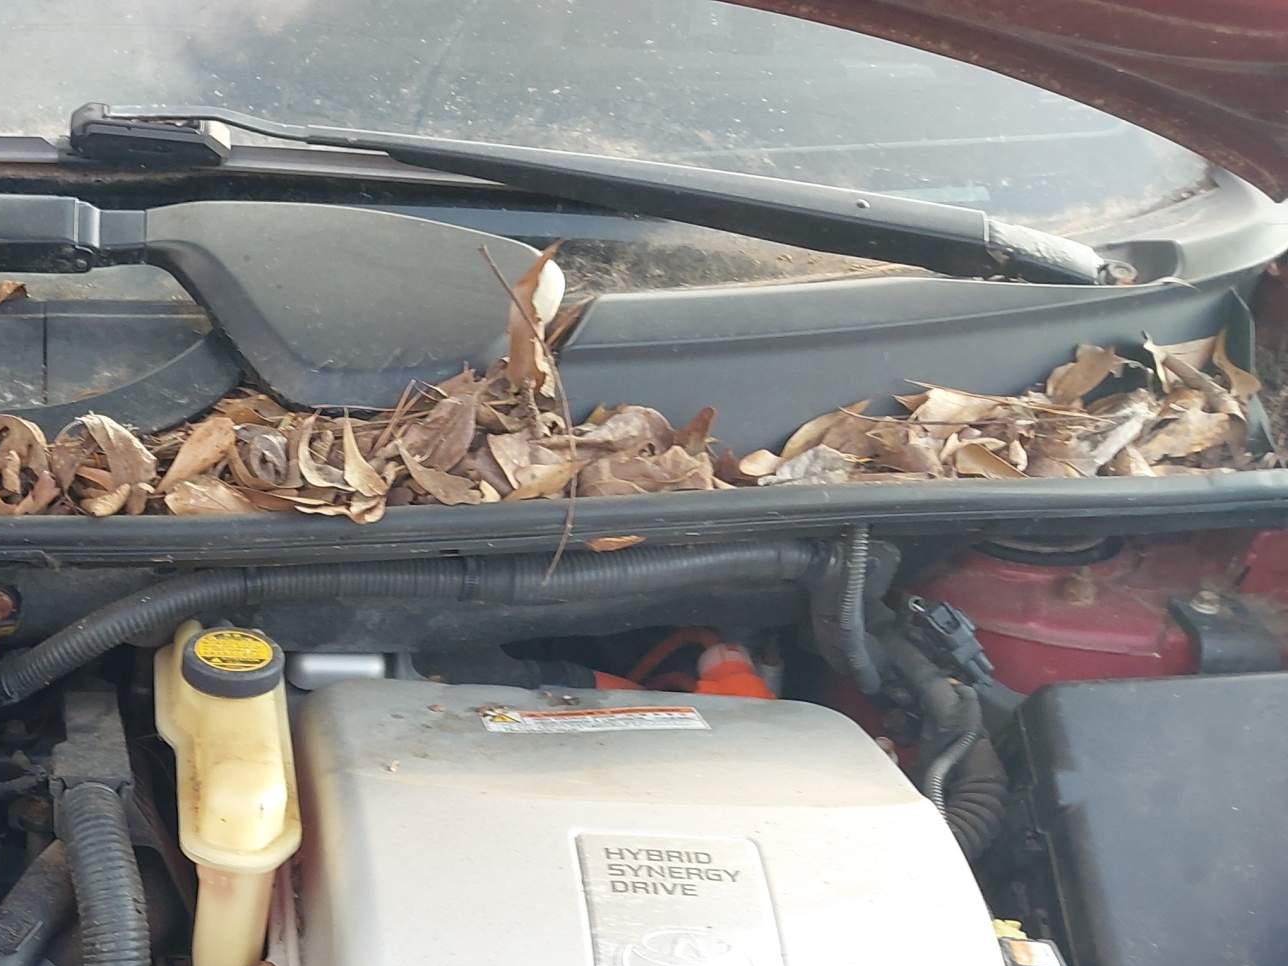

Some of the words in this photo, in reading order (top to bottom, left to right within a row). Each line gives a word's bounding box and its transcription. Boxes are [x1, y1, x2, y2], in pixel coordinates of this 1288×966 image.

[604, 847, 712, 865] HYBRID
[608, 864, 742, 883] SYNERGY
[611, 880, 699, 897] DRIVE
